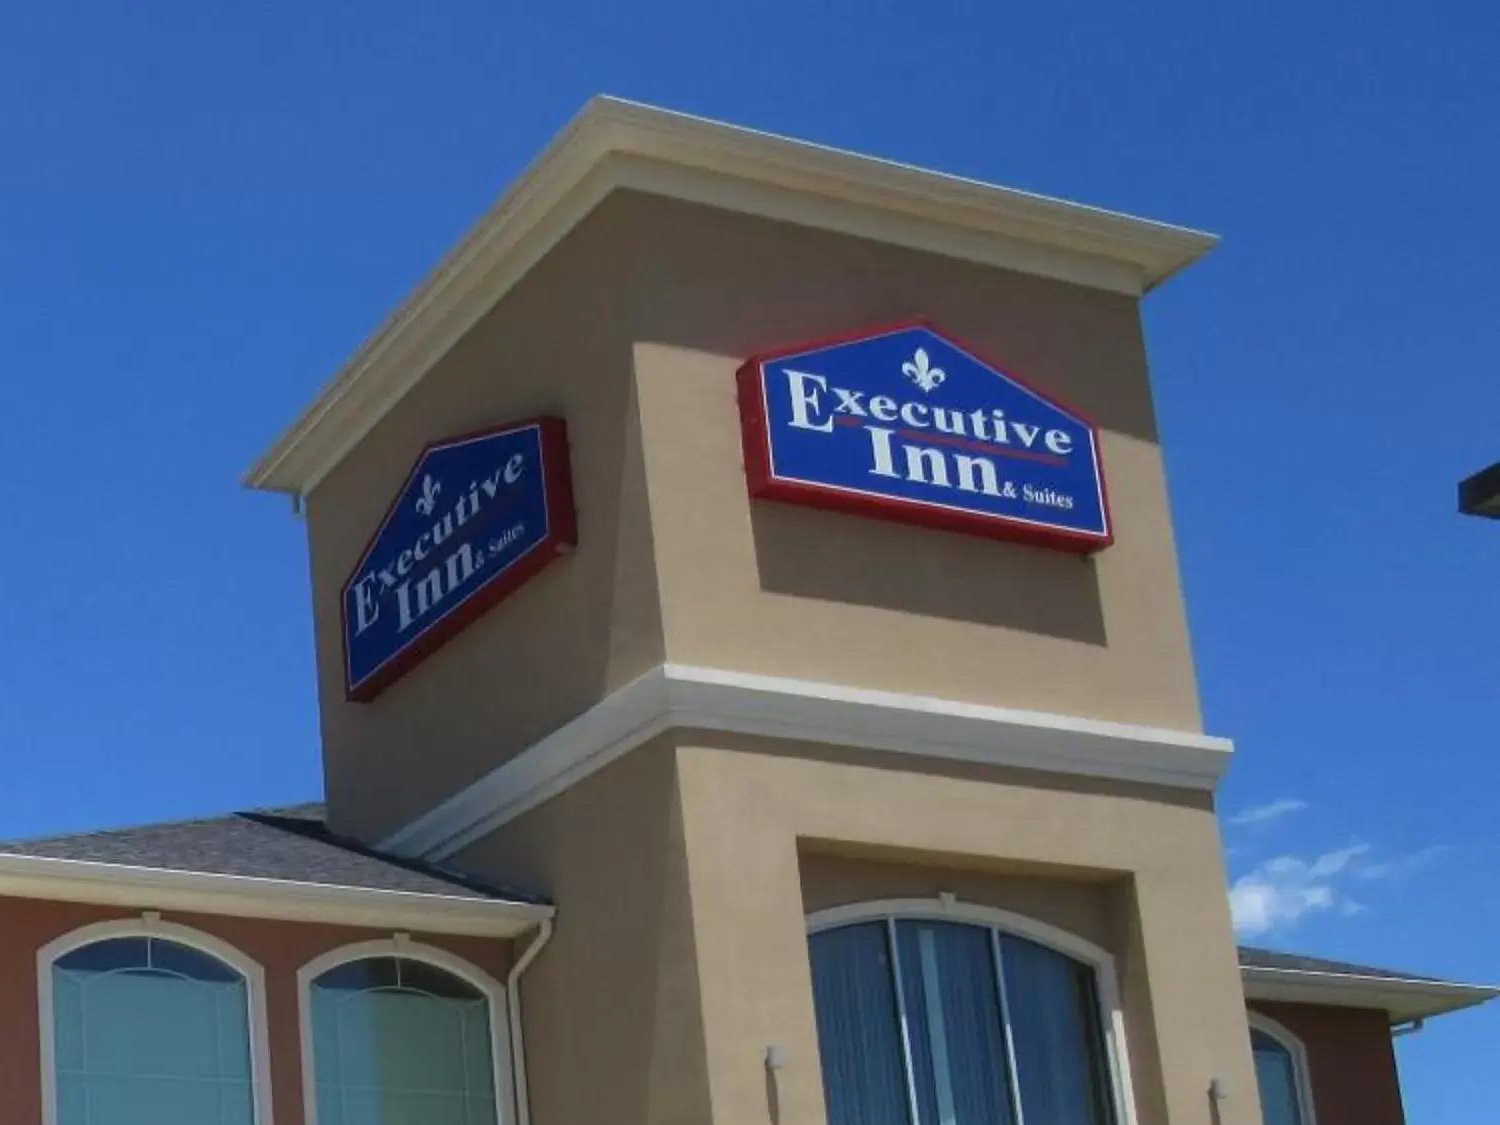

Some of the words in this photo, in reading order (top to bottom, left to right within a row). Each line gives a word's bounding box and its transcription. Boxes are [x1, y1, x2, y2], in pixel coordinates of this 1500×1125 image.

[782, 368, 1073, 455] Executive
[864, 425, 1002, 497] Inn
[1003, 481, 1018, 498] &
[1022, 484, 1074, 511] Suites
[354, 452, 524, 637] Executive
[396, 542, 476, 633] Inn
[488, 521, 526, 559] Suites
